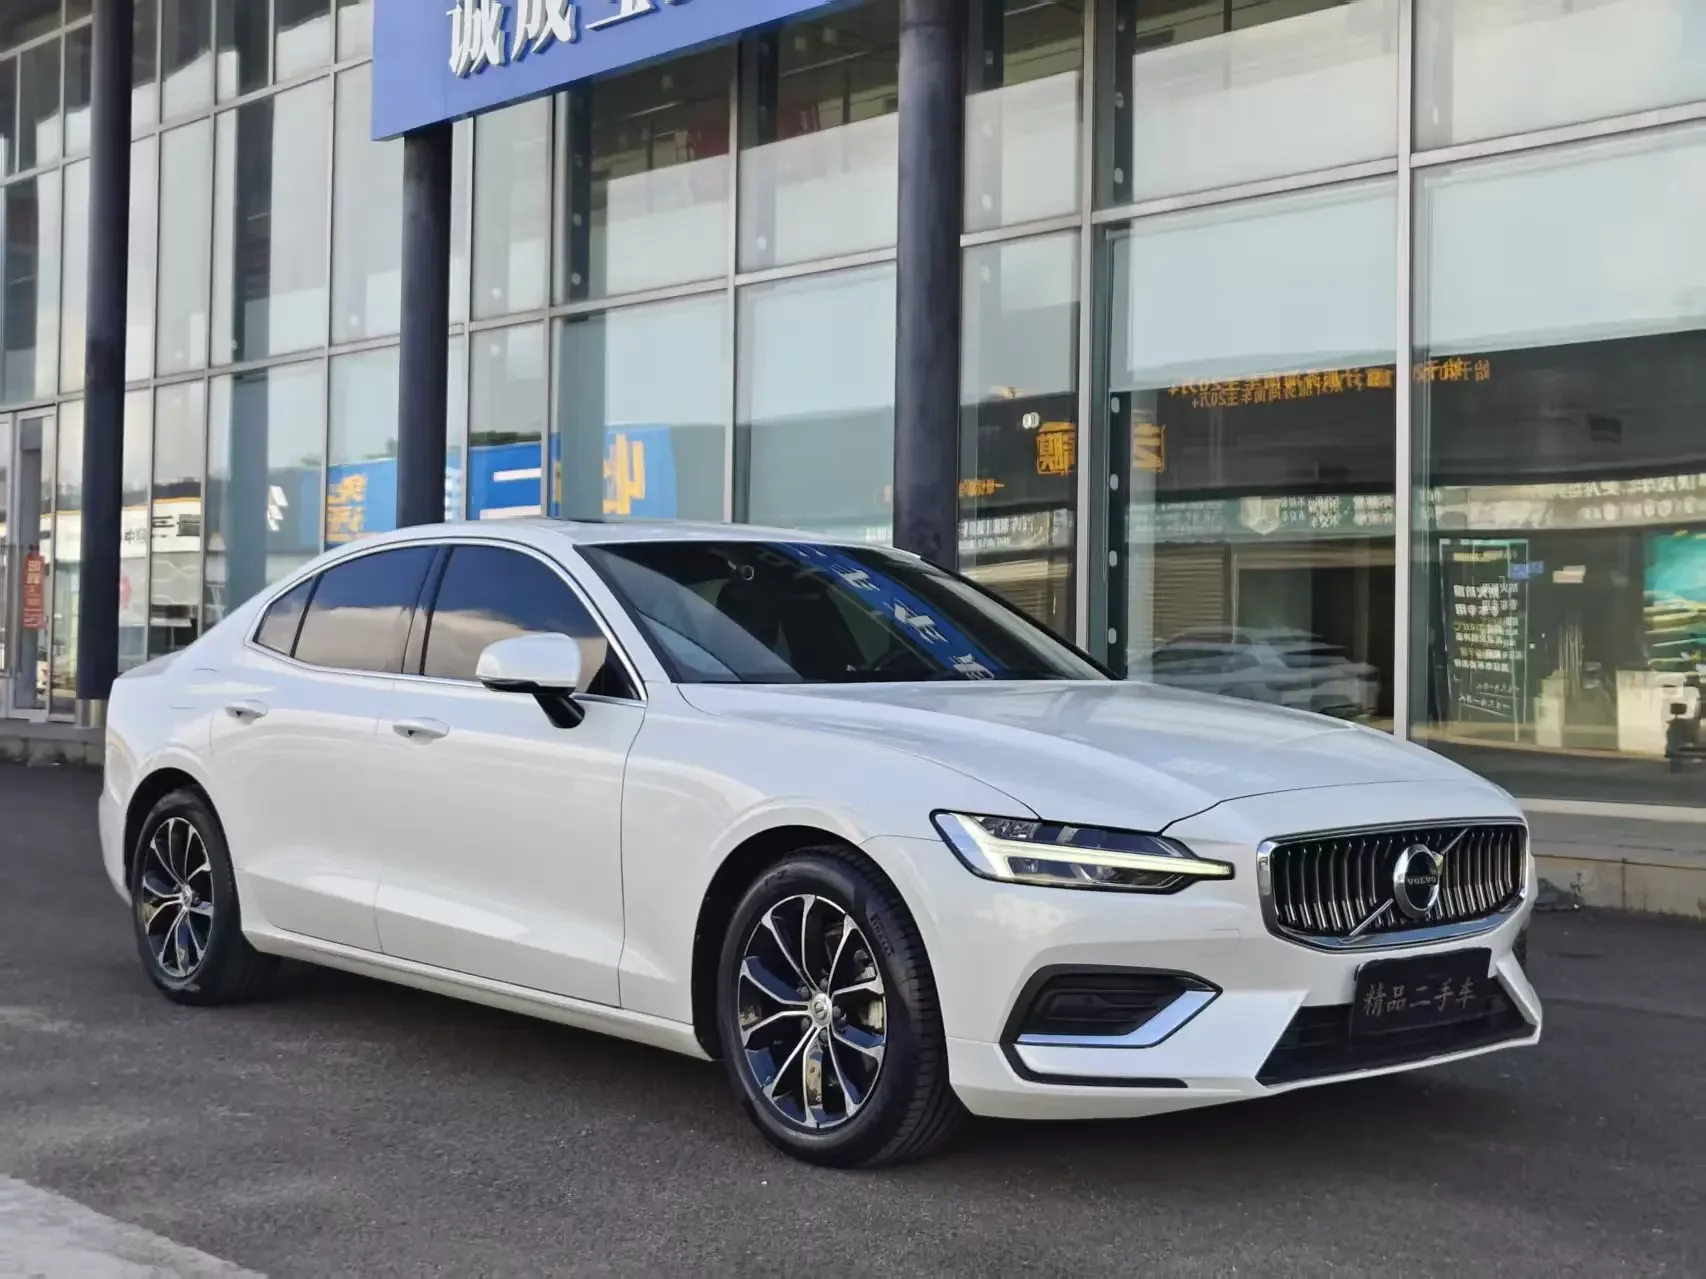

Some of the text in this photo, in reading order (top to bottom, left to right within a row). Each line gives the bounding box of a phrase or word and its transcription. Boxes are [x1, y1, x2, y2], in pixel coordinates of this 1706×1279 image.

[1407, 875, 1437, 885] VOLVO
[1363, 976, 1477, 1017] 精品二手车
